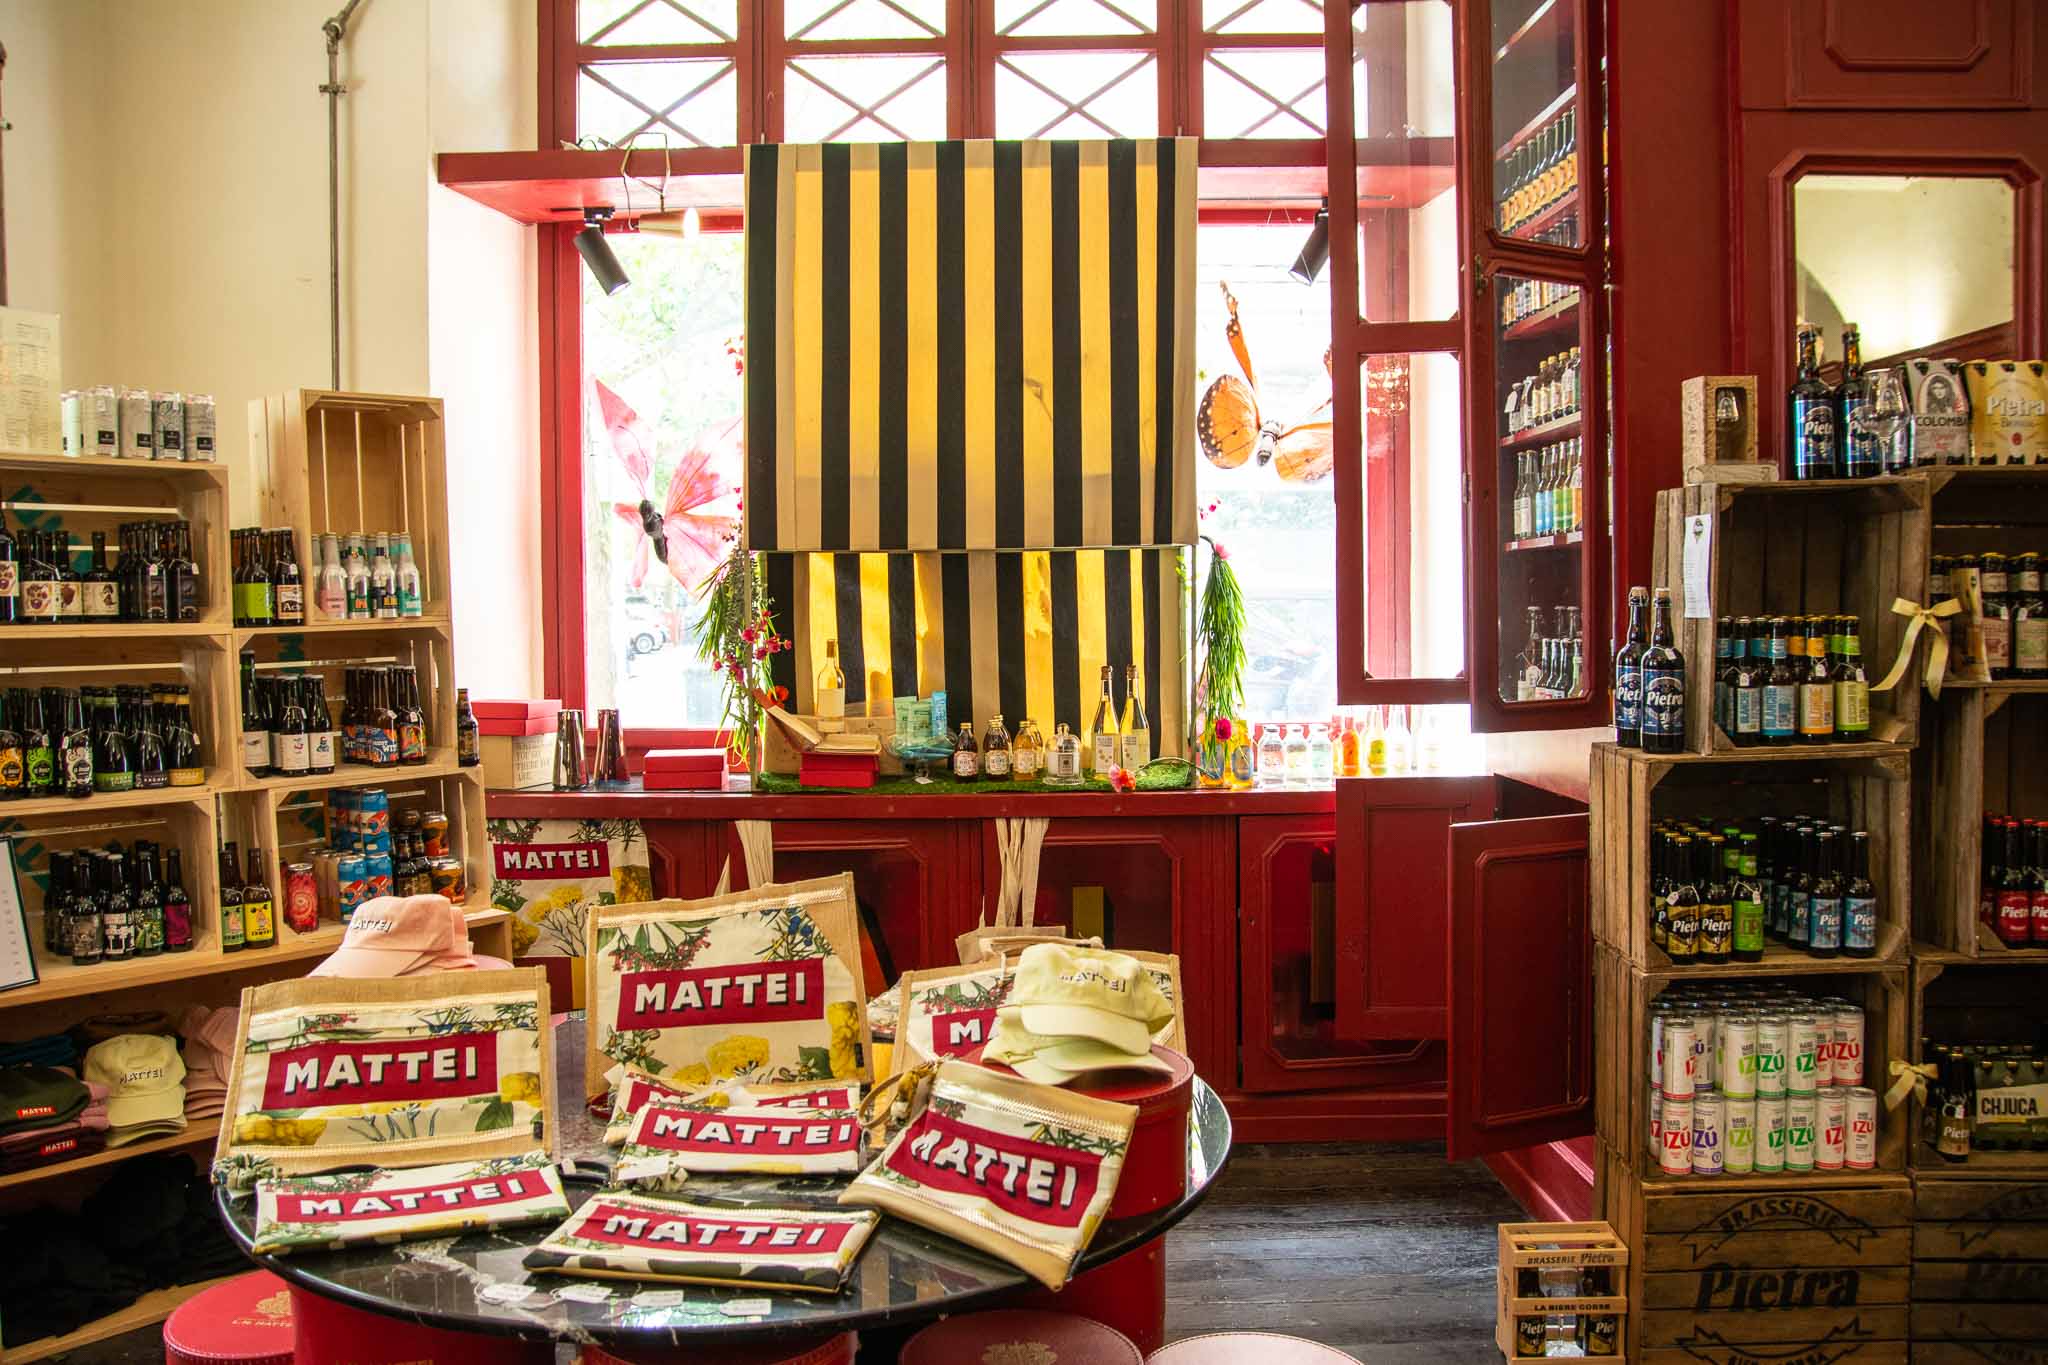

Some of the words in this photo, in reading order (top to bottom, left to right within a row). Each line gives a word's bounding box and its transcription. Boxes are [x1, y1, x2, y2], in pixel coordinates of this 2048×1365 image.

[503, 848, 600, 871] MATTEI
[634, 972, 807, 1014] MATTEI
[284, 1047, 478, 1094] MATTEI
[653, 1114, 851, 1145] MATTEI
[910, 1129, 1077, 1208] MATTEI
[300, 1178, 525, 1216] MATTEI
[602, 1214, 825, 1246] MATTEI
[1696, 1261, 1861, 1313] Pietra
